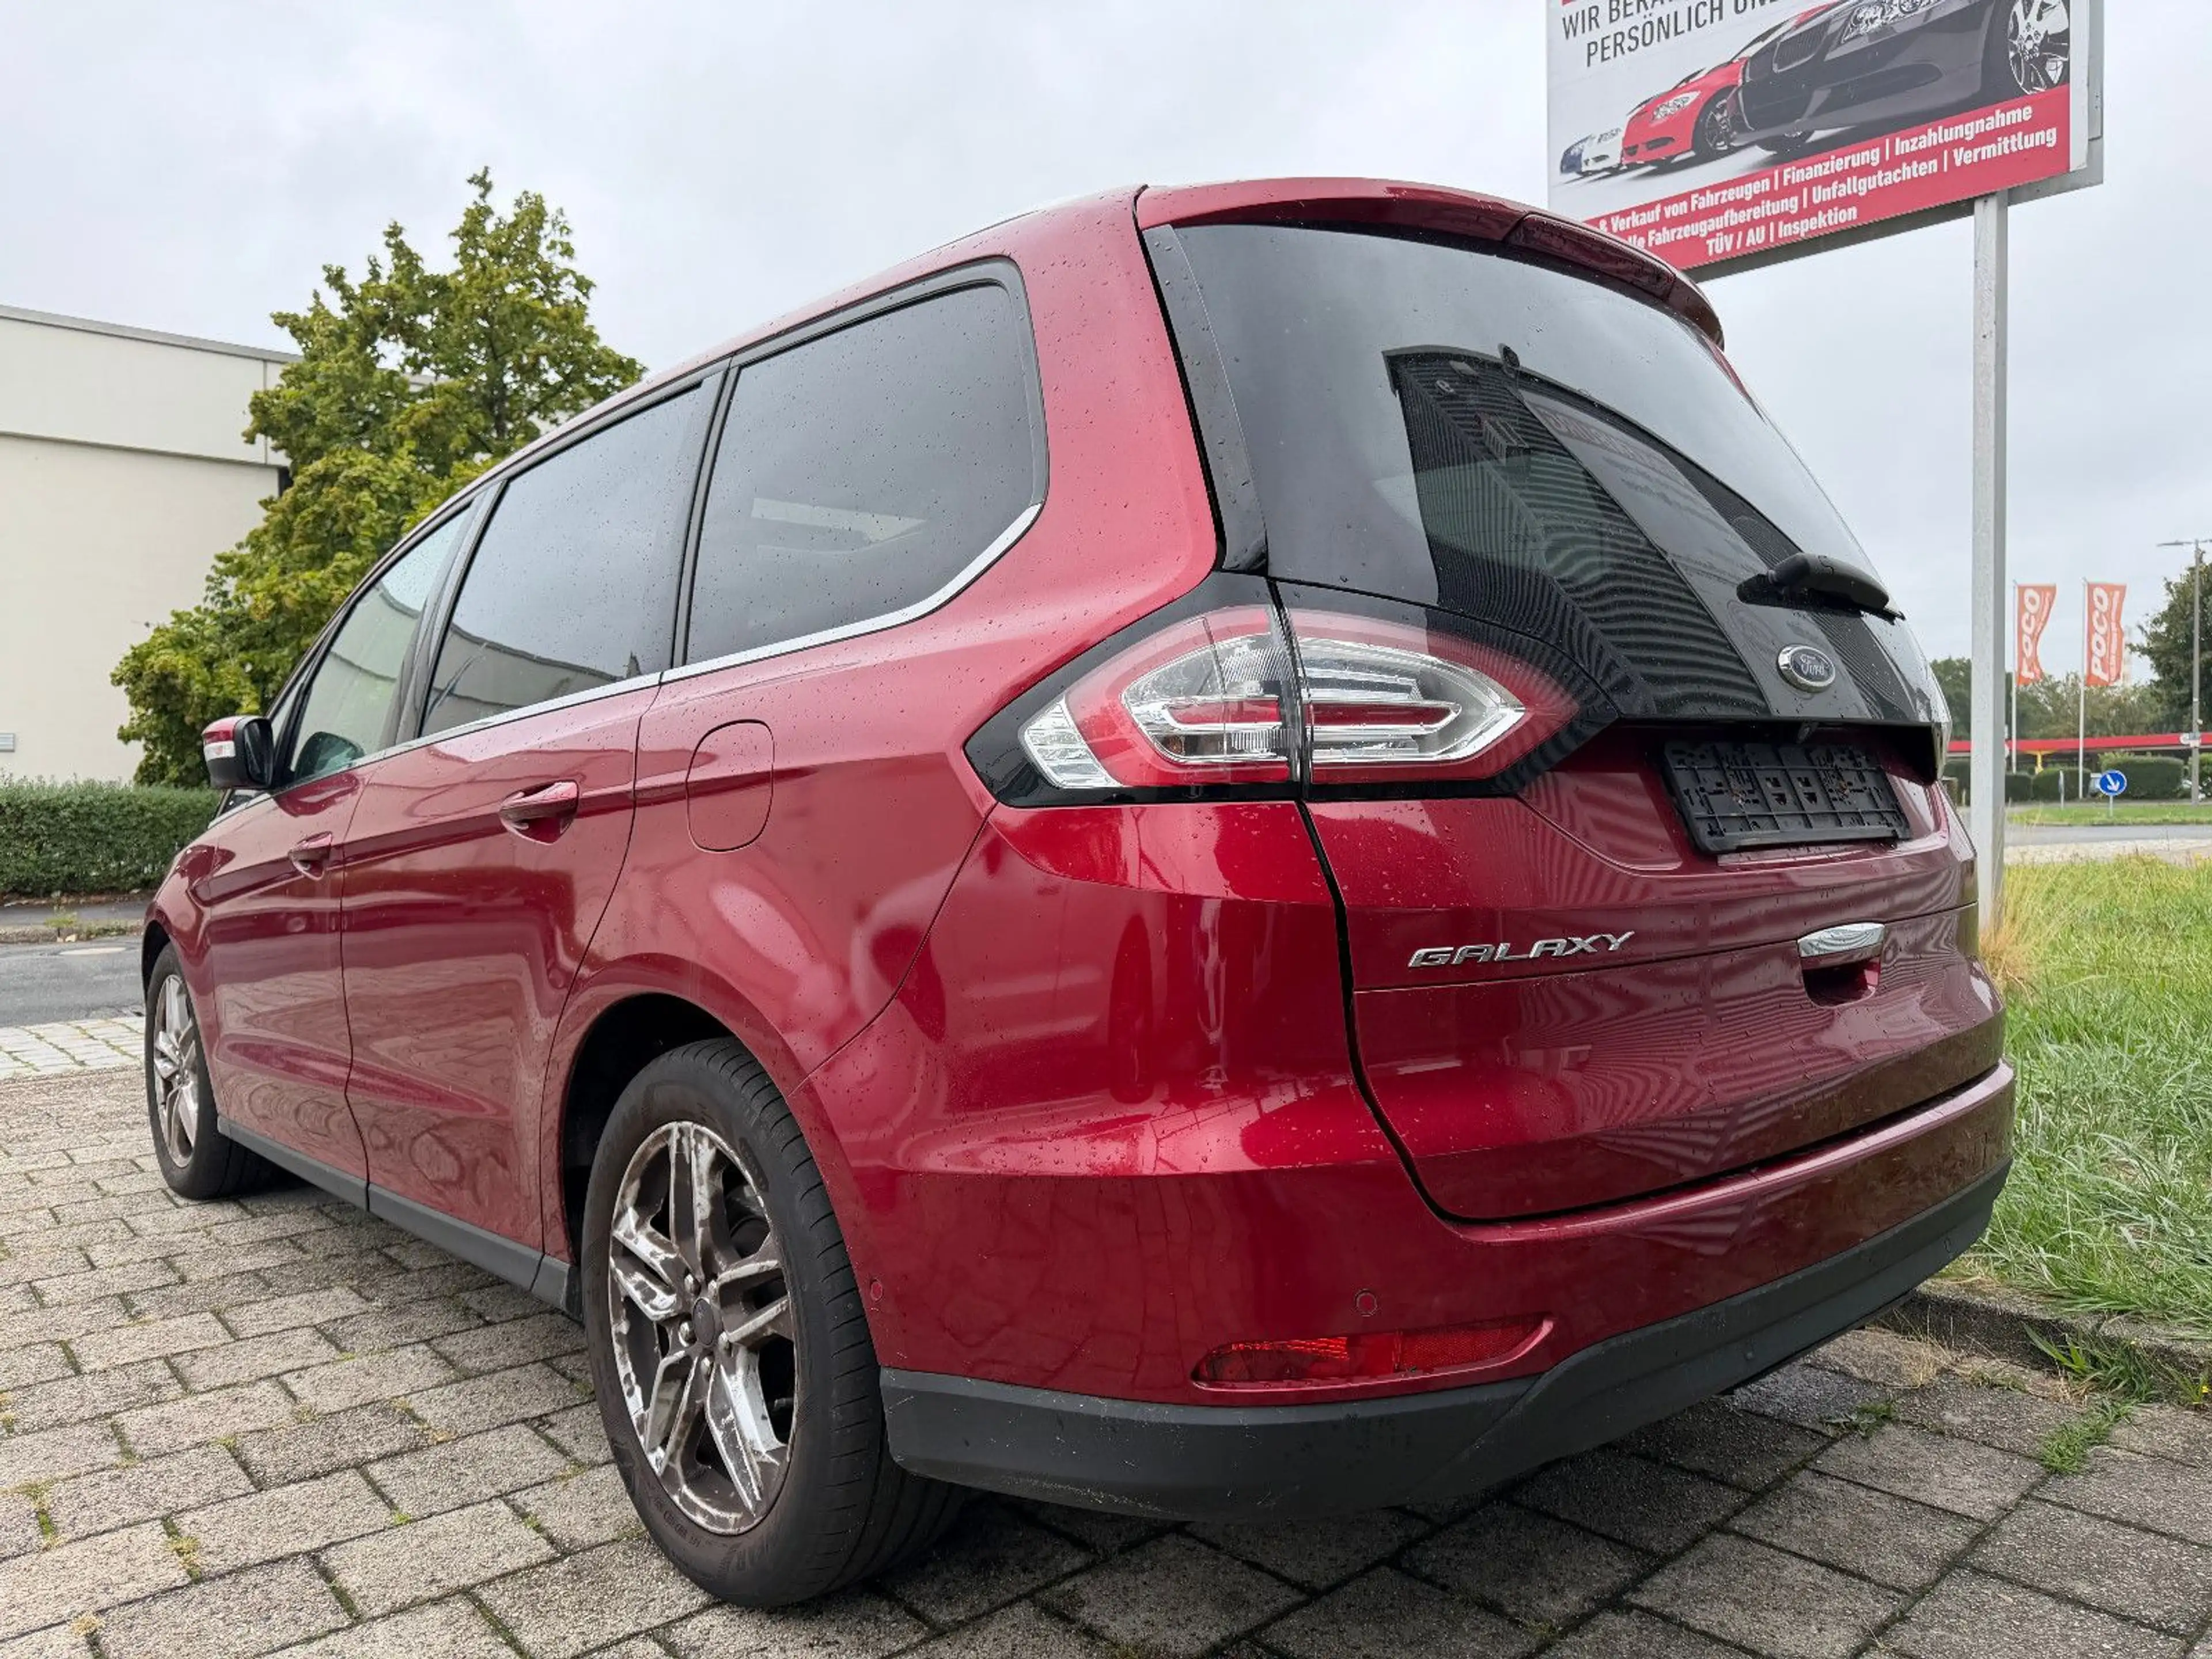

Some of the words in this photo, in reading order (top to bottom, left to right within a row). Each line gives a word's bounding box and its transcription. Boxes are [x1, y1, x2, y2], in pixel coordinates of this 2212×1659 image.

[1562, 5, 1600, 40] WIR
[1586, 0, 1723, 67] PERSÖNLICH
[1611, 203, 1661, 233] Verkauf
[1664, 200, 1688, 219] von
[1691, 177, 1770, 212] Fahrzeugen
[1783, 147, 1880, 186] Finanzierung
[1894, 105, 2033, 156] Inzahlungnahme
[1648, 195, 1798, 247] Fahrzeugaufbereitung
[1812, 158, 1938, 204] Unfallgutachten
[1952, 127, 2058, 166] Vermittlung
[1706, 232, 1734, 256] TÜV
[1745, 225, 1766, 247] AU
[1778, 206, 1858, 239] Inspektion
[2091, 586, 2110, 683] POCO
[1408, 930, 1635, 968] GALAXY
